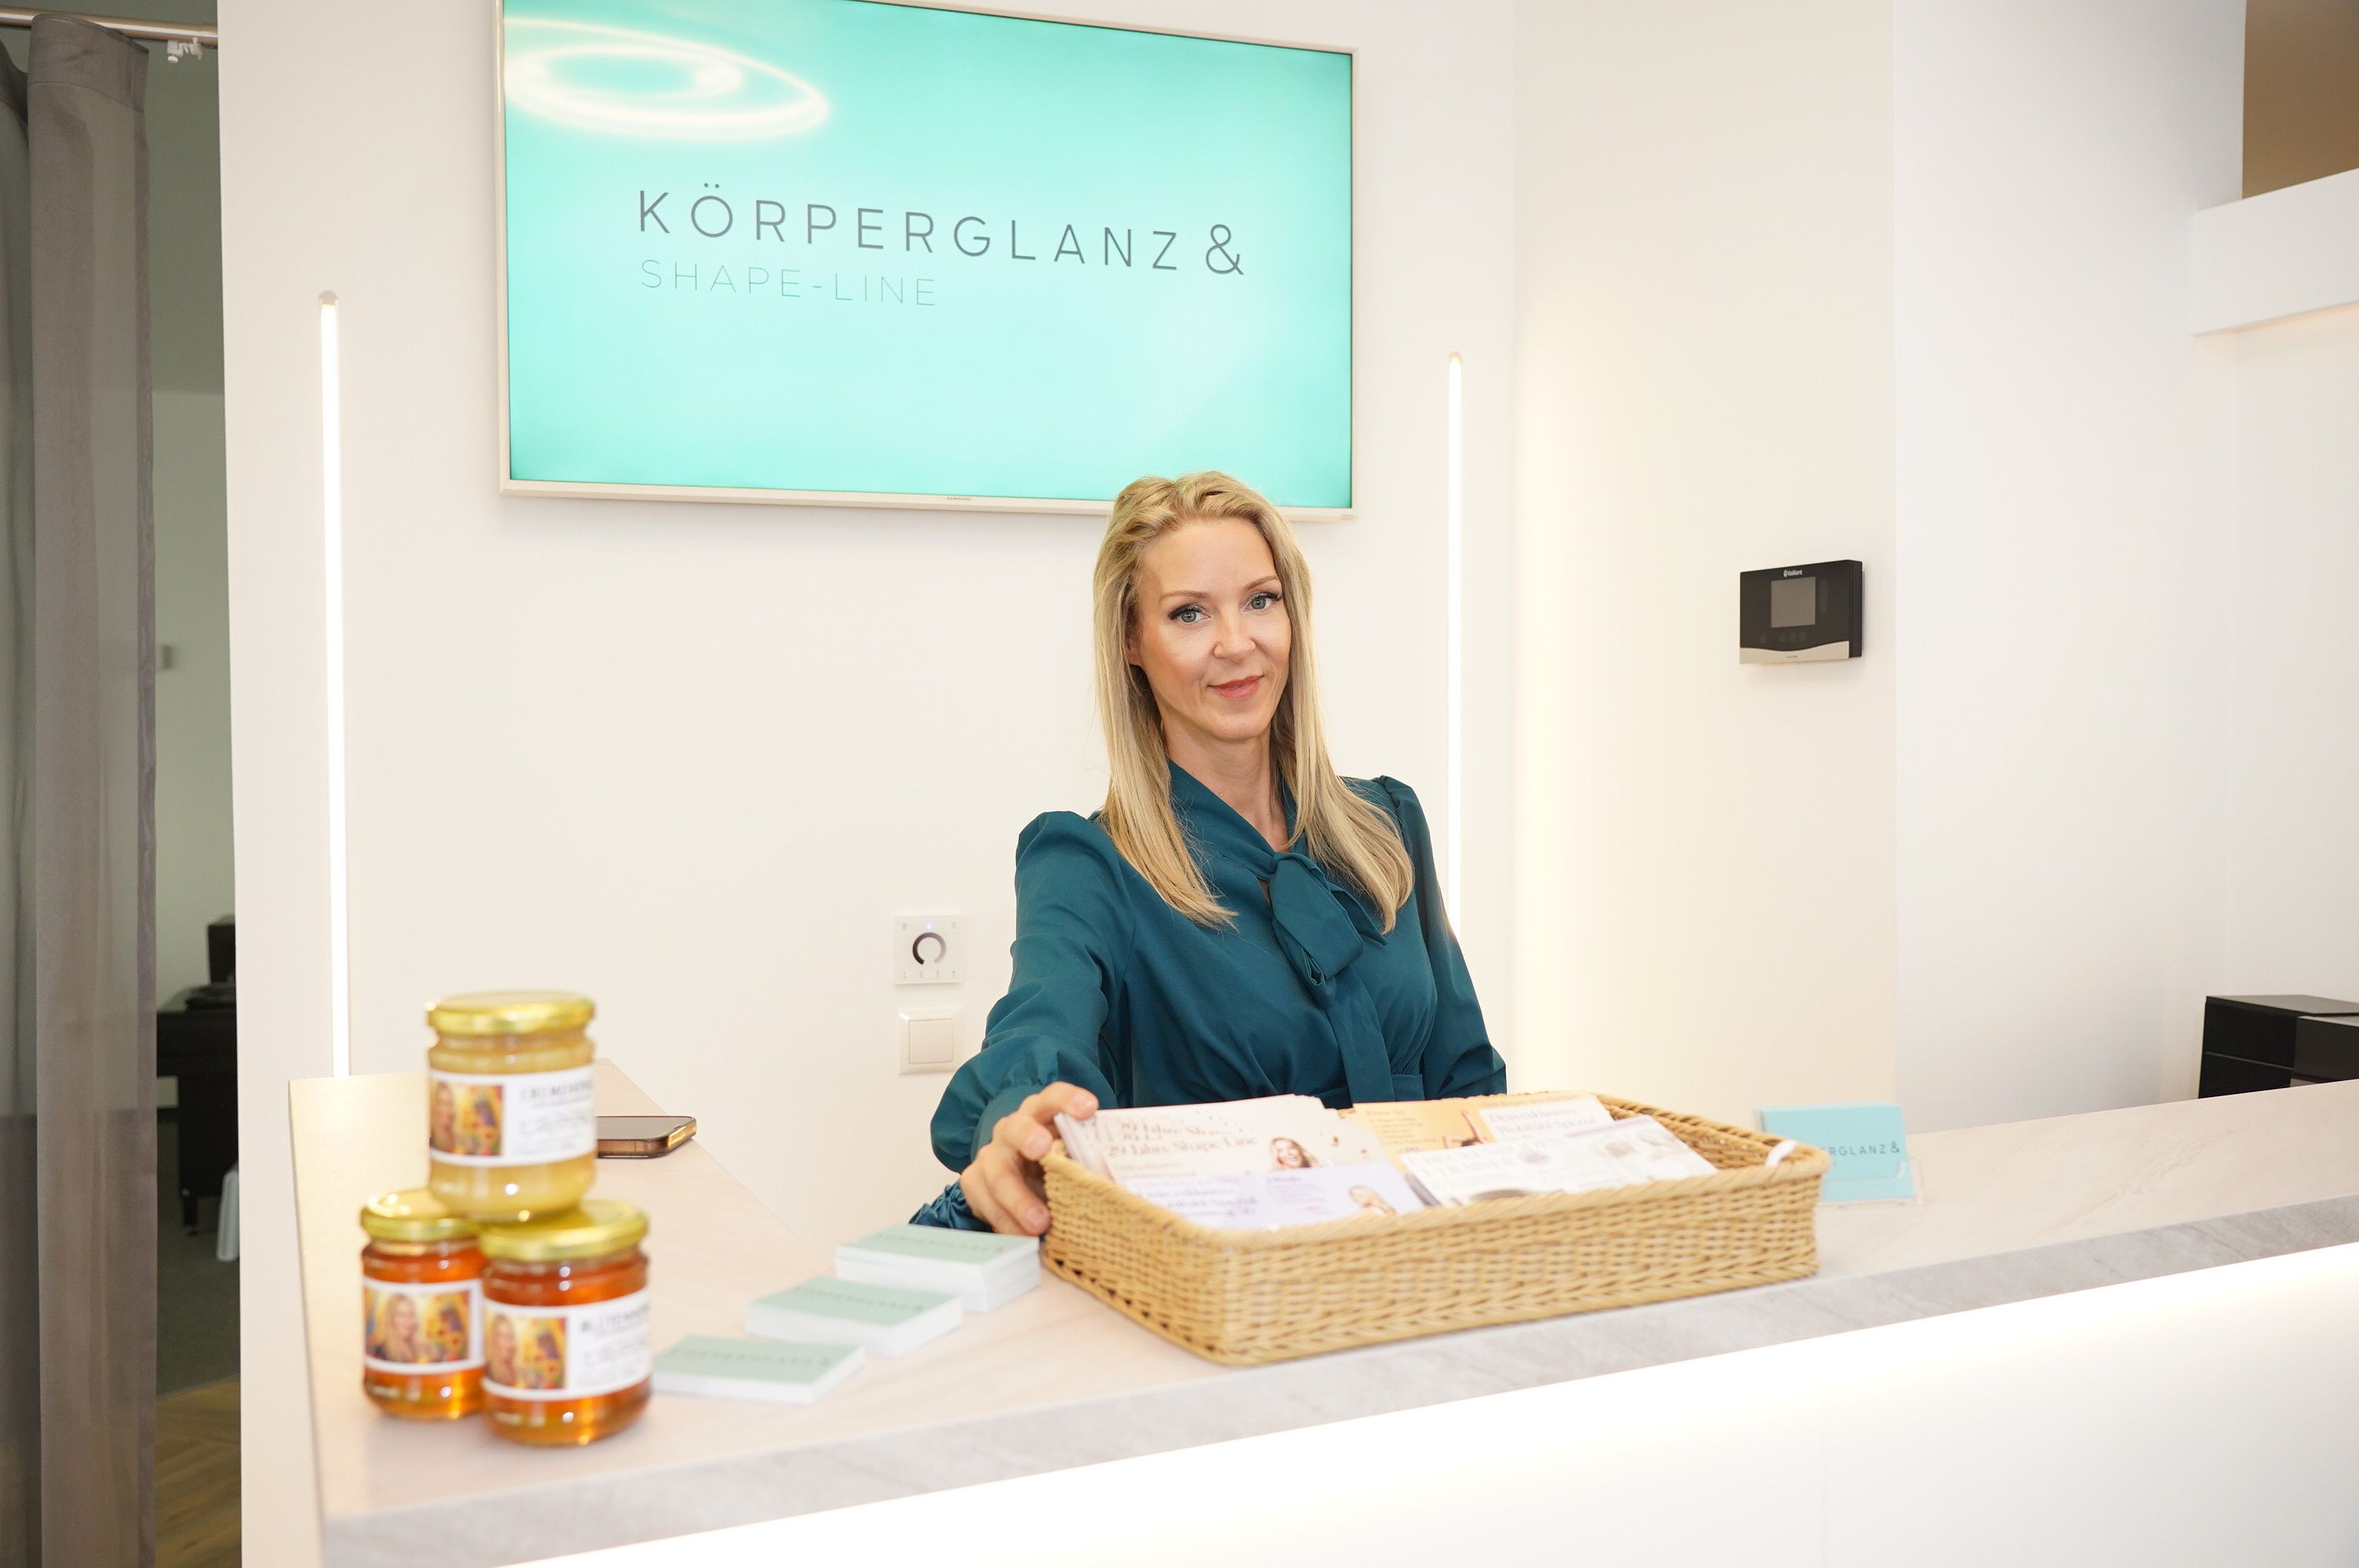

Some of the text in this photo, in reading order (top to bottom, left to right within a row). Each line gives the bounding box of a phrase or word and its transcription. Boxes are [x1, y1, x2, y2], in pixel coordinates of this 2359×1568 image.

[638, 181, 1245, 277] KÖRPERGLANZ &
[640, 258, 936, 307] SHAPE-LINE
[1821, 1141, 1900, 1156] RGLANZ &
